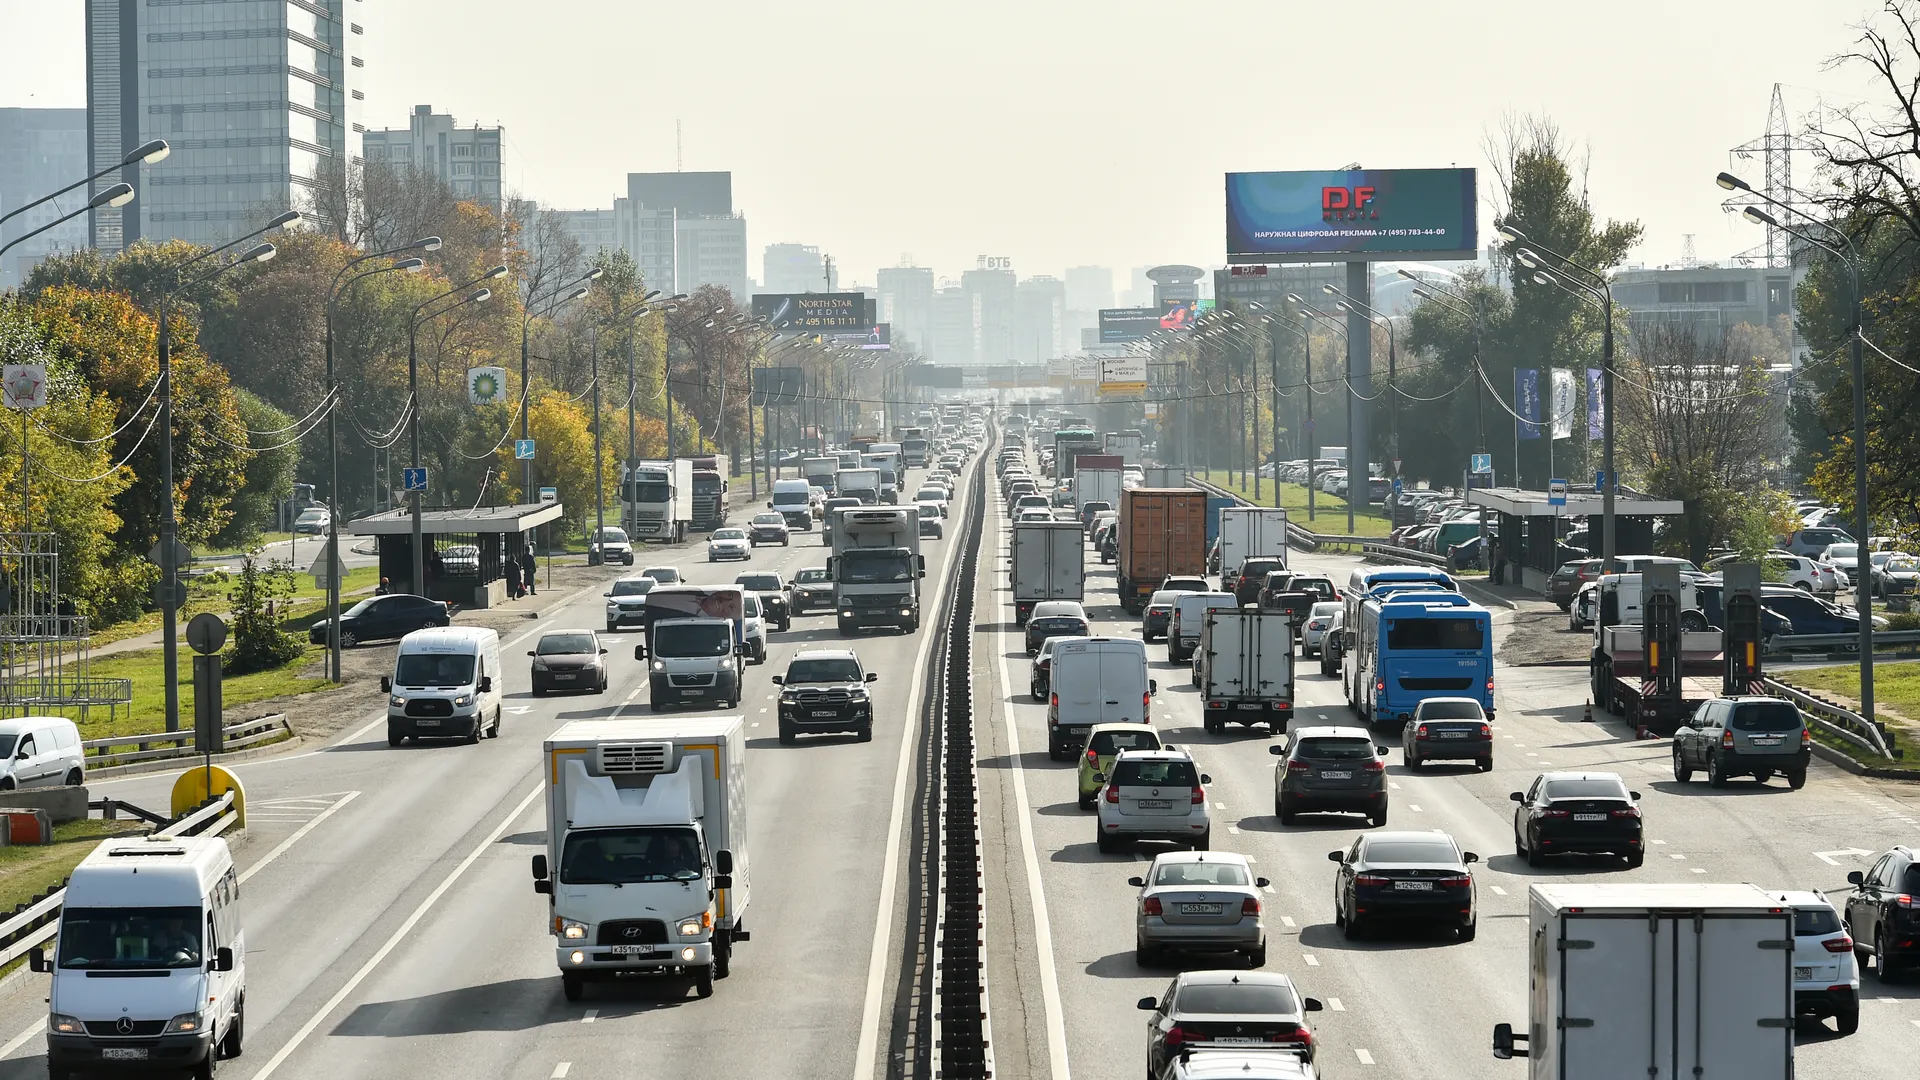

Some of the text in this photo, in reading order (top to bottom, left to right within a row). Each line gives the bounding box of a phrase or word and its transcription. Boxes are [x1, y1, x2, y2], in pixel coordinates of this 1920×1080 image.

[1322, 187, 1375, 209] DF
[1298, 230, 1339, 238] ЦИФРОВАЯ
[988, 257, 1011, 268] ВТБ
[799, 299, 853, 308] NORTH STAR
[794, 318, 803, 326] +7
[823, 317, 835, 325] 116
